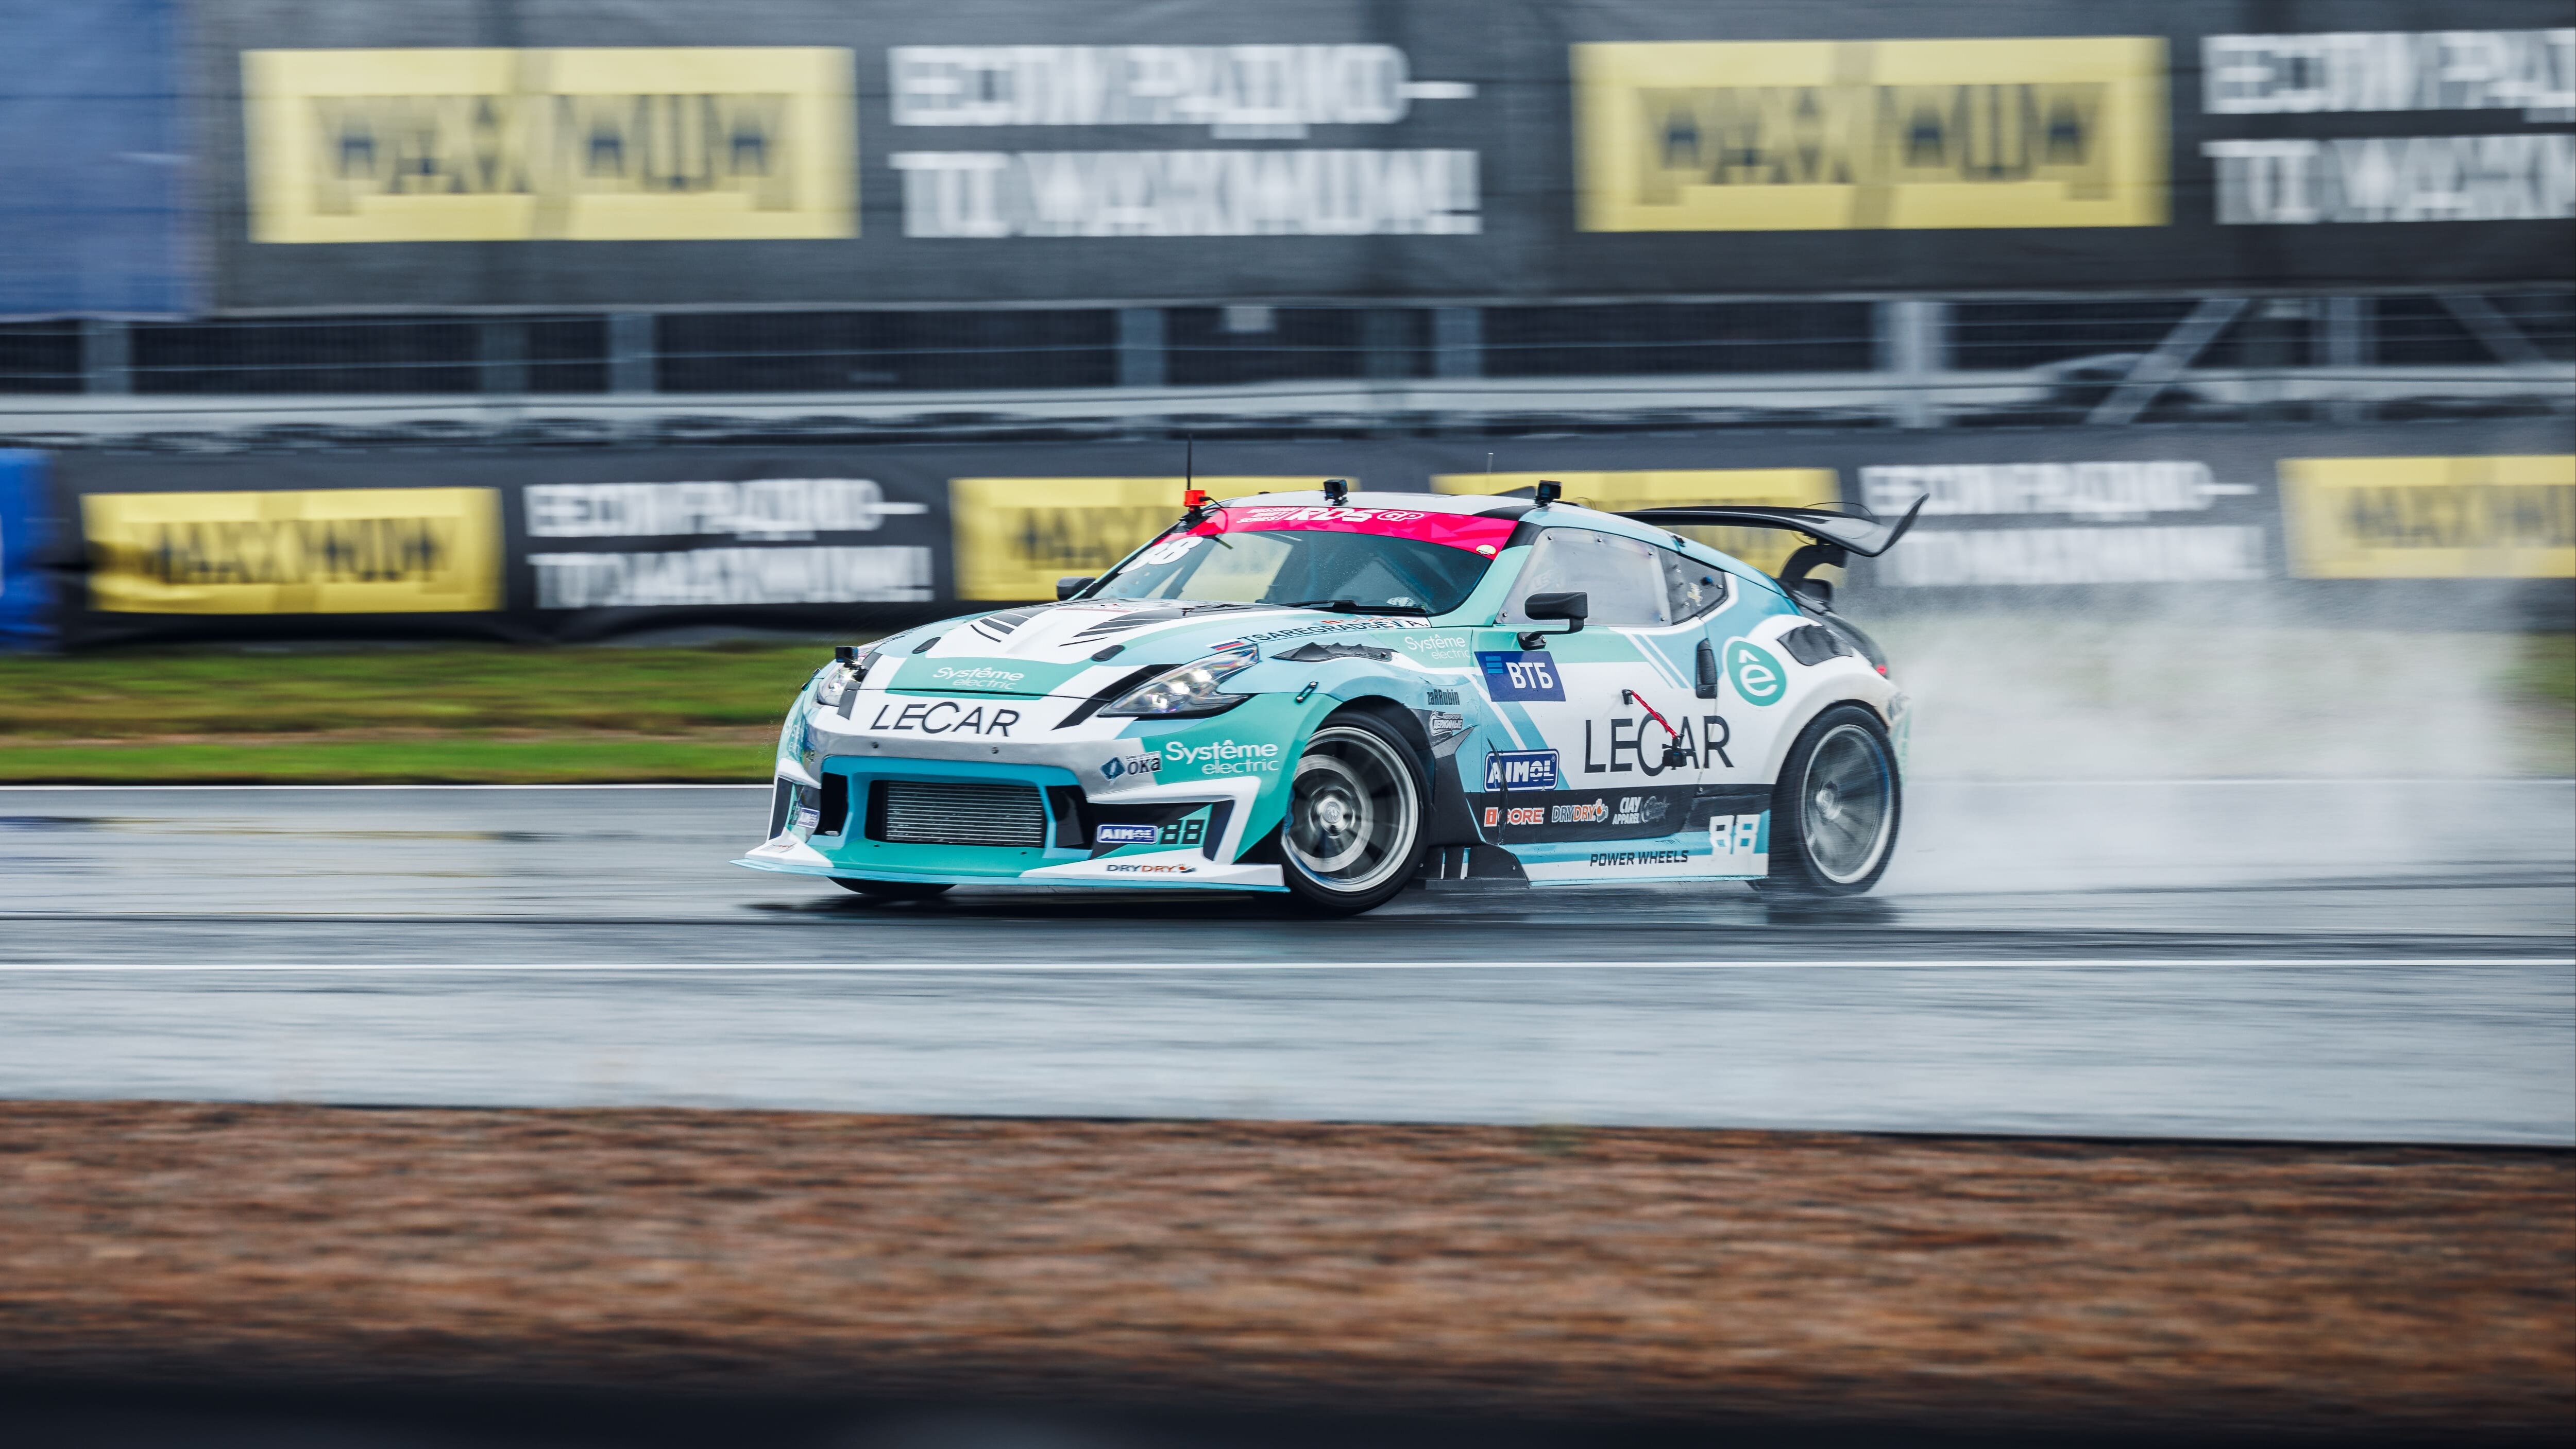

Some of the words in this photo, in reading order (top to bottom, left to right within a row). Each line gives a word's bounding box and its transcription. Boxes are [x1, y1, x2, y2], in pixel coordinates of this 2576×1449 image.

[1283, 507, 1389, 522] RDS
[1377, 510, 1425, 522] GP
[1404, 634, 1466, 652] Systême
[1432, 649, 1471, 660] electric
[933, 667, 1025, 681] Systême
[1505, 662, 1553, 689] ВТБ
[953, 678, 1018, 690] electric
[870, 701, 1020, 737] LECAR
[1165, 739, 1279, 764] Systême
[1584, 712, 1735, 776] LECAR
[1201, 759, 1280, 774] electric
[1487, 760, 1555, 783] AIMOL
[1612, 813, 1640, 825] APPAREL
[1160, 819, 1206, 844] 88
[1709, 814, 1761, 855] 88
[1590, 852, 1635, 867] POWER
[1638, 850, 1689, 864] WHEELS
